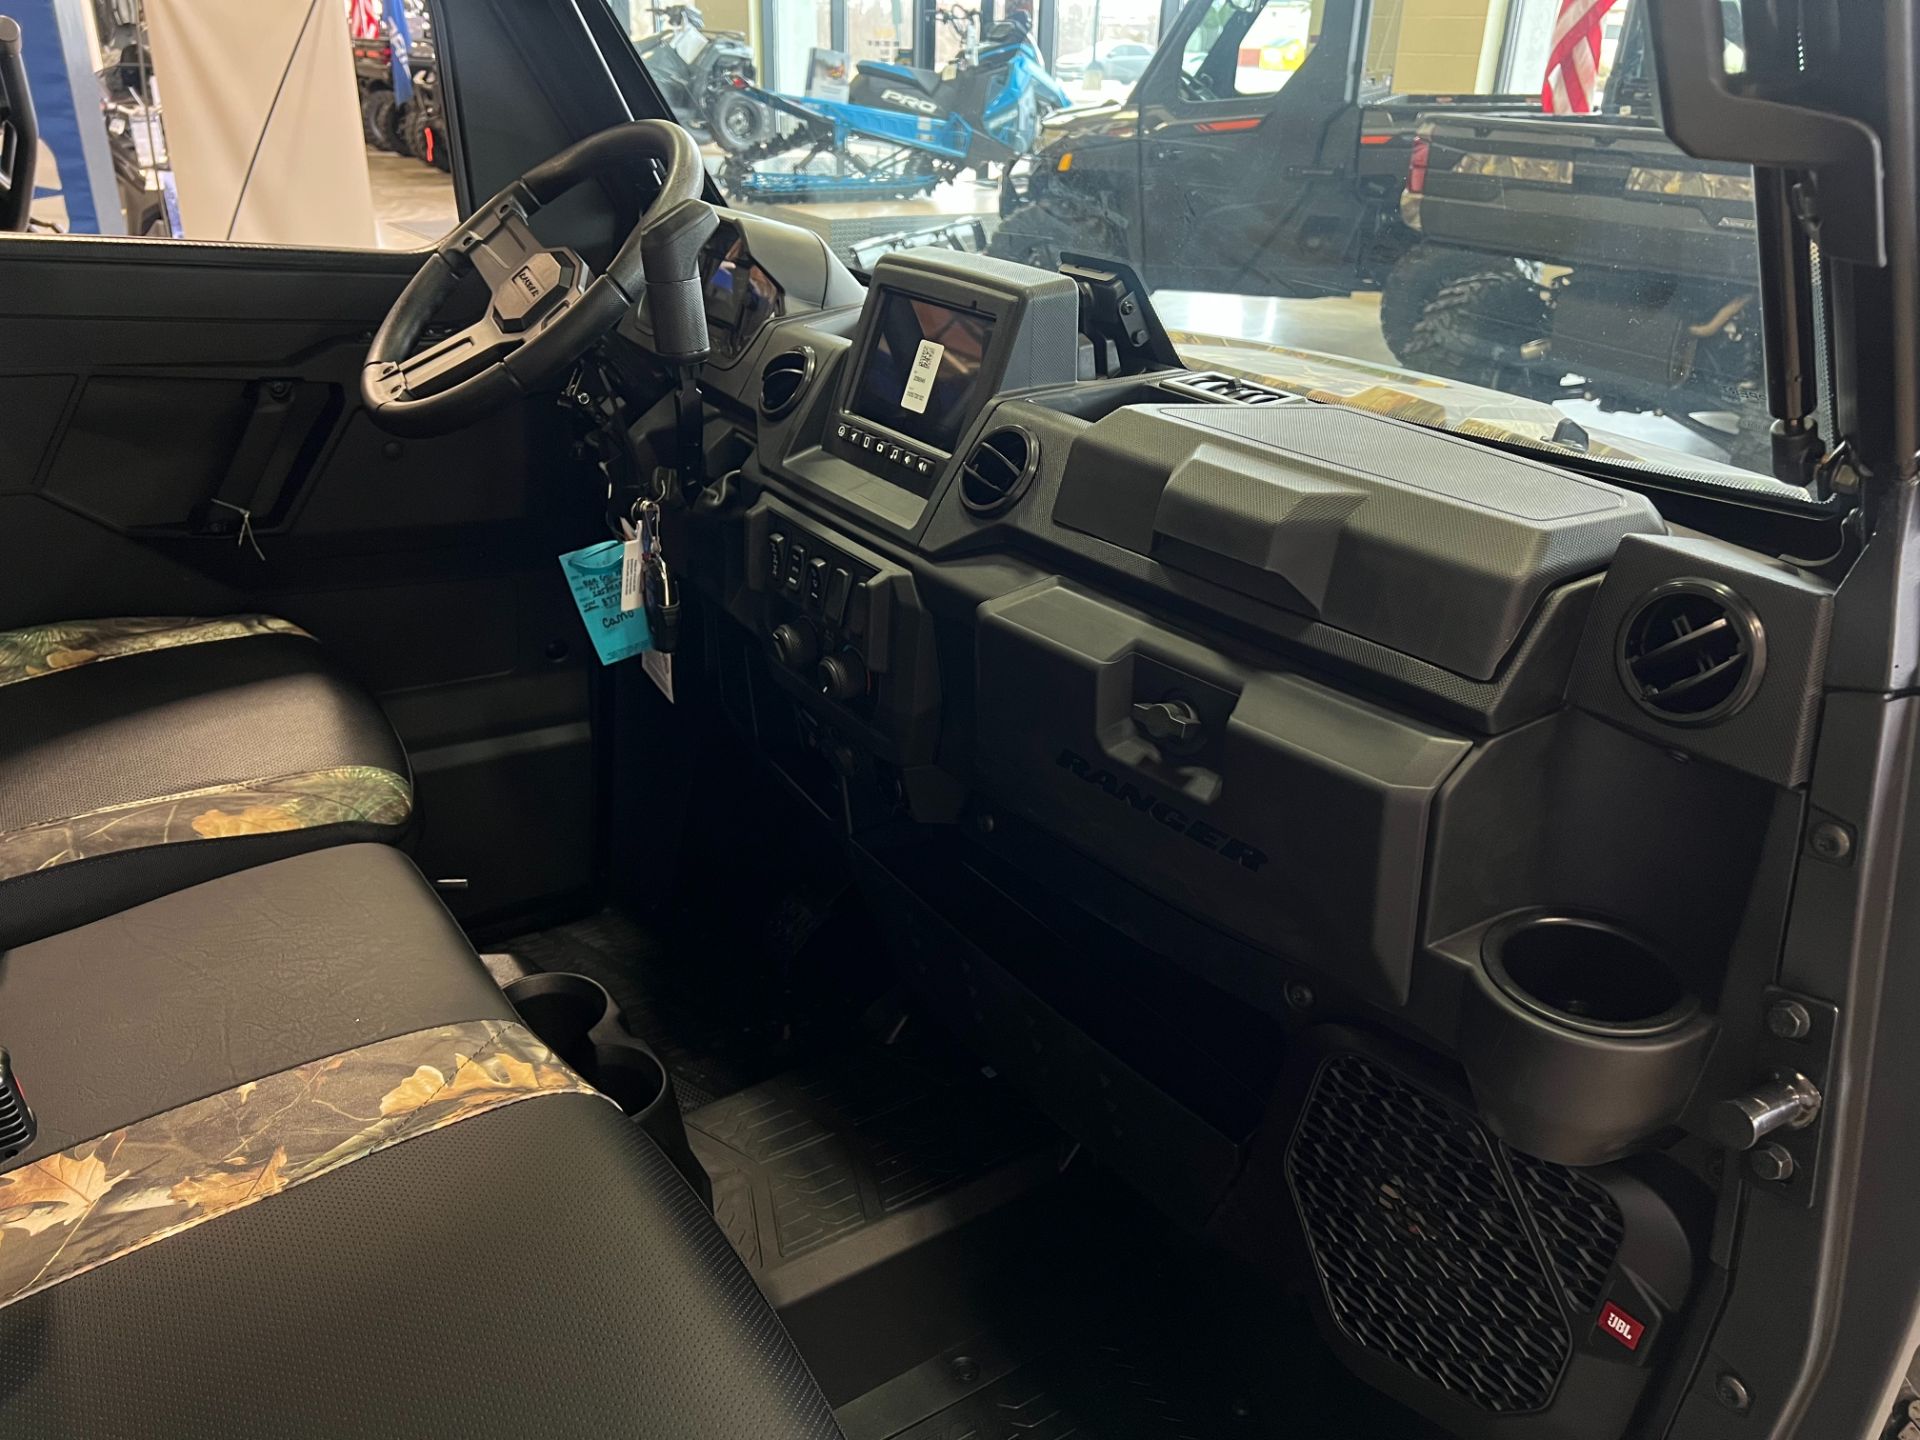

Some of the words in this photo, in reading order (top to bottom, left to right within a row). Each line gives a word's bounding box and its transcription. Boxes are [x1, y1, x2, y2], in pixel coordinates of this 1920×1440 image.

[881, 89, 938, 113] PRO
[1056, 749, 1268, 871] RANGER
[1607, 1311, 1633, 1340] JBL
